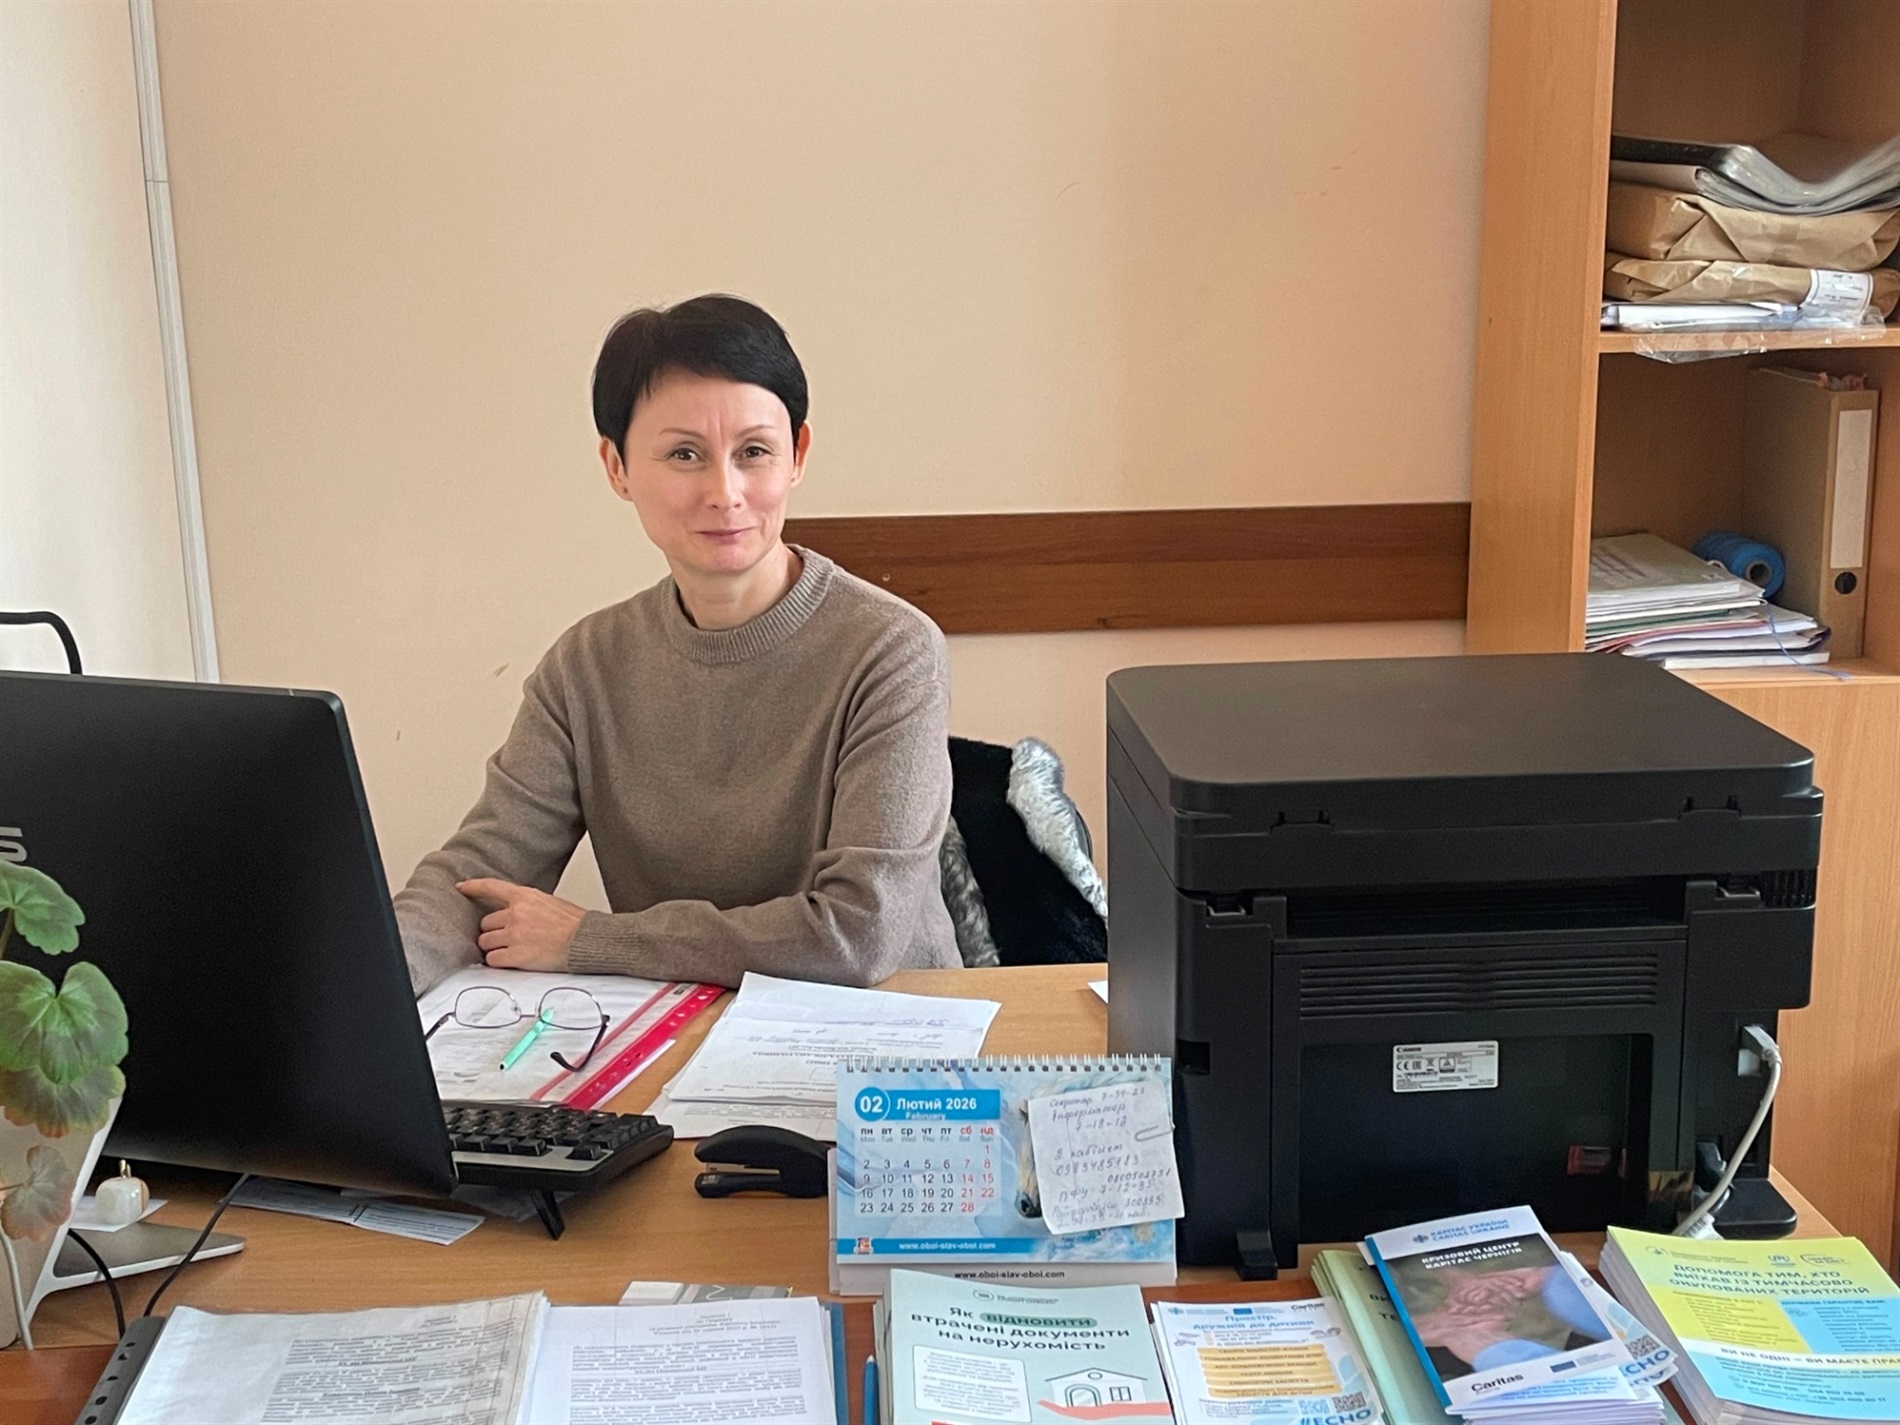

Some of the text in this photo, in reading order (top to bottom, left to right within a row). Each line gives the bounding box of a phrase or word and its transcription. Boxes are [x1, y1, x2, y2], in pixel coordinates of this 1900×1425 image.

[860, 1096, 977, 1113] 02 Лютий 2026
[905, 1112, 946, 1120] February
[901, 1128, 913, 1137] ср
[960, 1126, 972, 1135] сб
[980, 1127, 994, 1136] нд
[985, 1146, 989, 1154] 1
[863, 1159, 991, 1169] 2 3 4 5 6 7 8
[863, 1174, 994, 1184] 9 10 11 12 13 14 15
[862, 1188, 994, 1198] 16 17 18 19 20 21 22
[860, 1203, 974, 1213] 23 24 25 26 27 28
[1421, 1241, 1520, 1264] КРИЗОВИЙ ЦЕНТР
[1425, 1247, 1523, 1270] КАРІТАС ЧЕРНІГІВ
[1673, 1271, 1732, 1284] ВИЇХАВ
[1752, 1279, 1854, 1287] ТИМЧАСОВО
[1674, 1263, 1762, 1279] ДОПОМОГА
[1669, 1278, 1871, 1296] ОКУПОВАНИХ ТЕРИТОРІЙ
[949, 1307, 1091, 1327] Як відновити
[911, 1314, 1130, 1341] втрачені документи
[938, 1329, 1106, 1351] на нерухомість
[1471, 1374, 1524, 1392] Caritas
